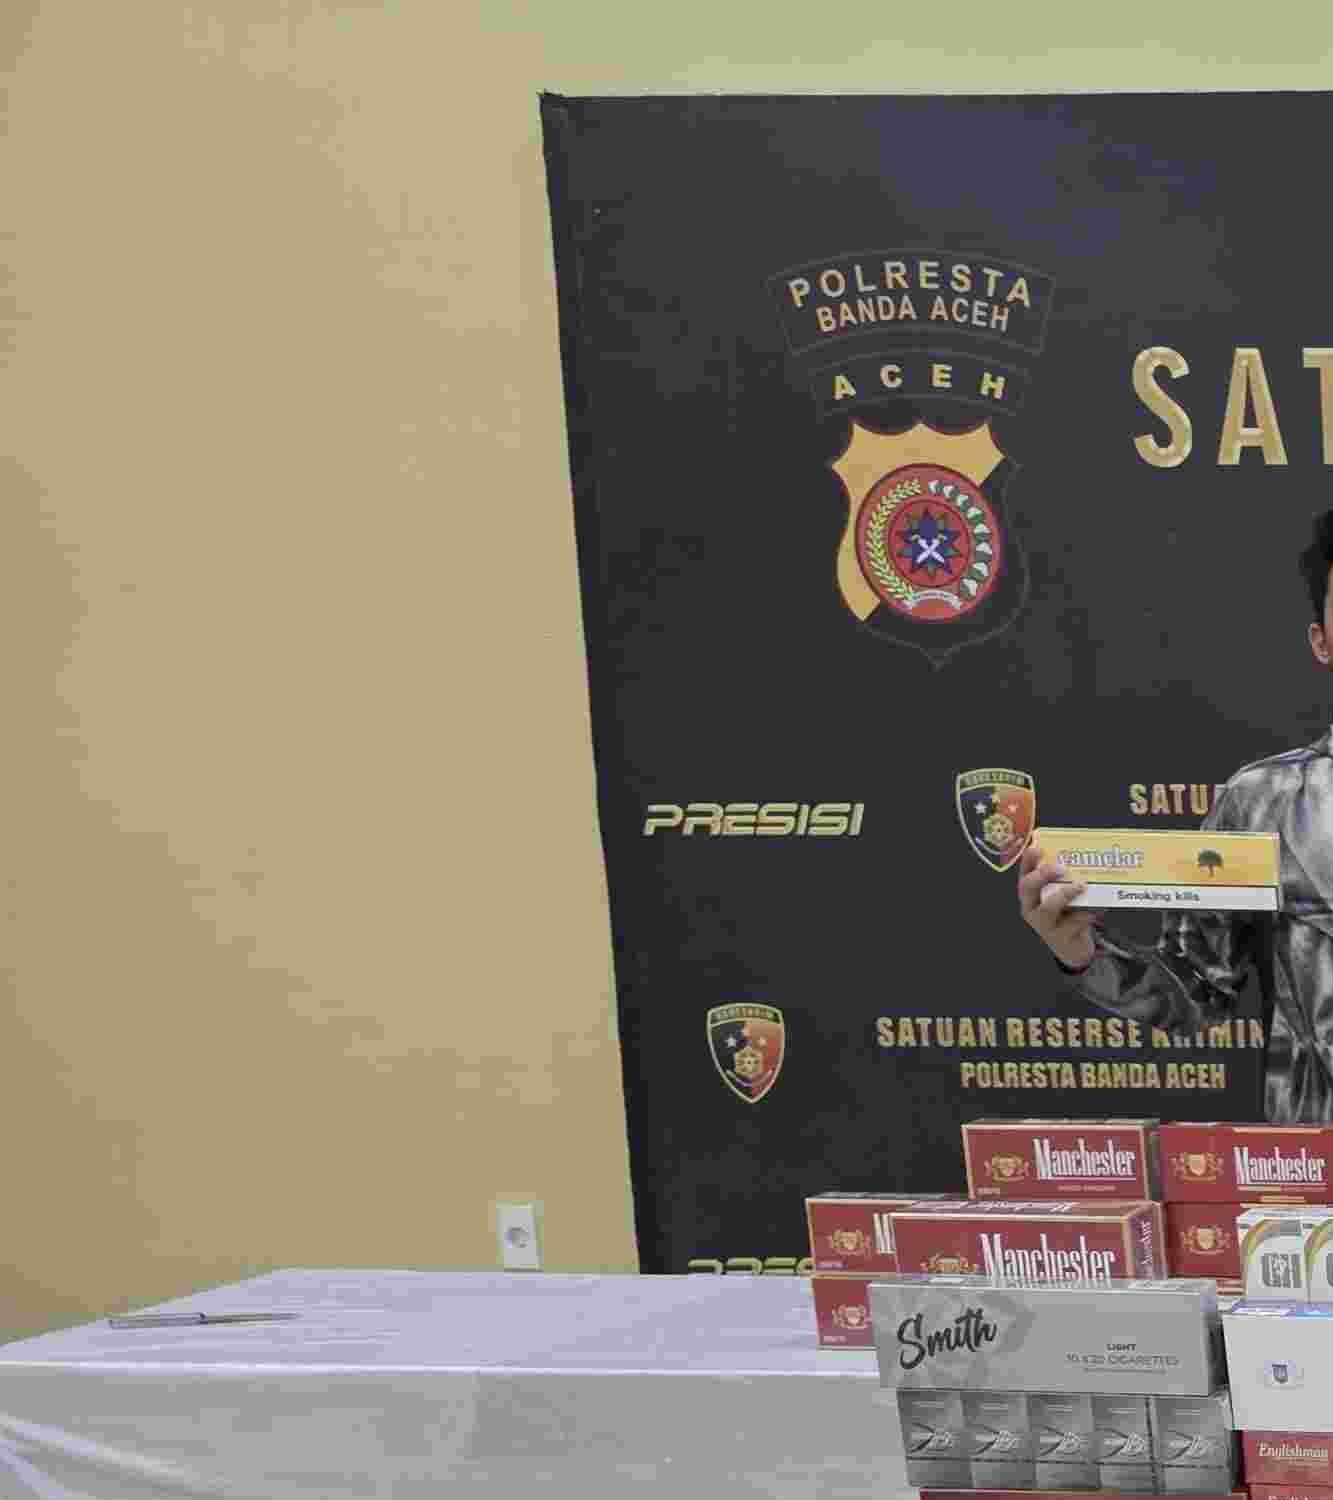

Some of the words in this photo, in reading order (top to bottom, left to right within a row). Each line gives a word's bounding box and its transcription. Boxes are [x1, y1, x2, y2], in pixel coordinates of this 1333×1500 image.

[788, 259, 1034, 310] POLRESTA
[816, 294, 919, 334] BANDA
[930, 296, 1011, 334] ACEH
[833, 362, 1007, 401] ACEH
[1130, 783, 1218, 815] SATU
[643, 801, 865, 837] PRESISI
[1117, 889, 1171, 902] Smoking
[875, 1016, 996, 1048] SATUAN
[1006, 1016, 1143, 1048] RESERSE
[960, 1063, 1077, 1088] POLRESTA
[1081, 1063, 1161, 1088] BANDA
[1166, 1063, 1226, 1088] ACEH
[1233, 1146, 1328, 1185] Manchester
[896, 1303, 998, 1370] Smith
[1107, 1343, 1137, 1351] LIGHT
[1258, 1444, 1329, 1461] Englishman
